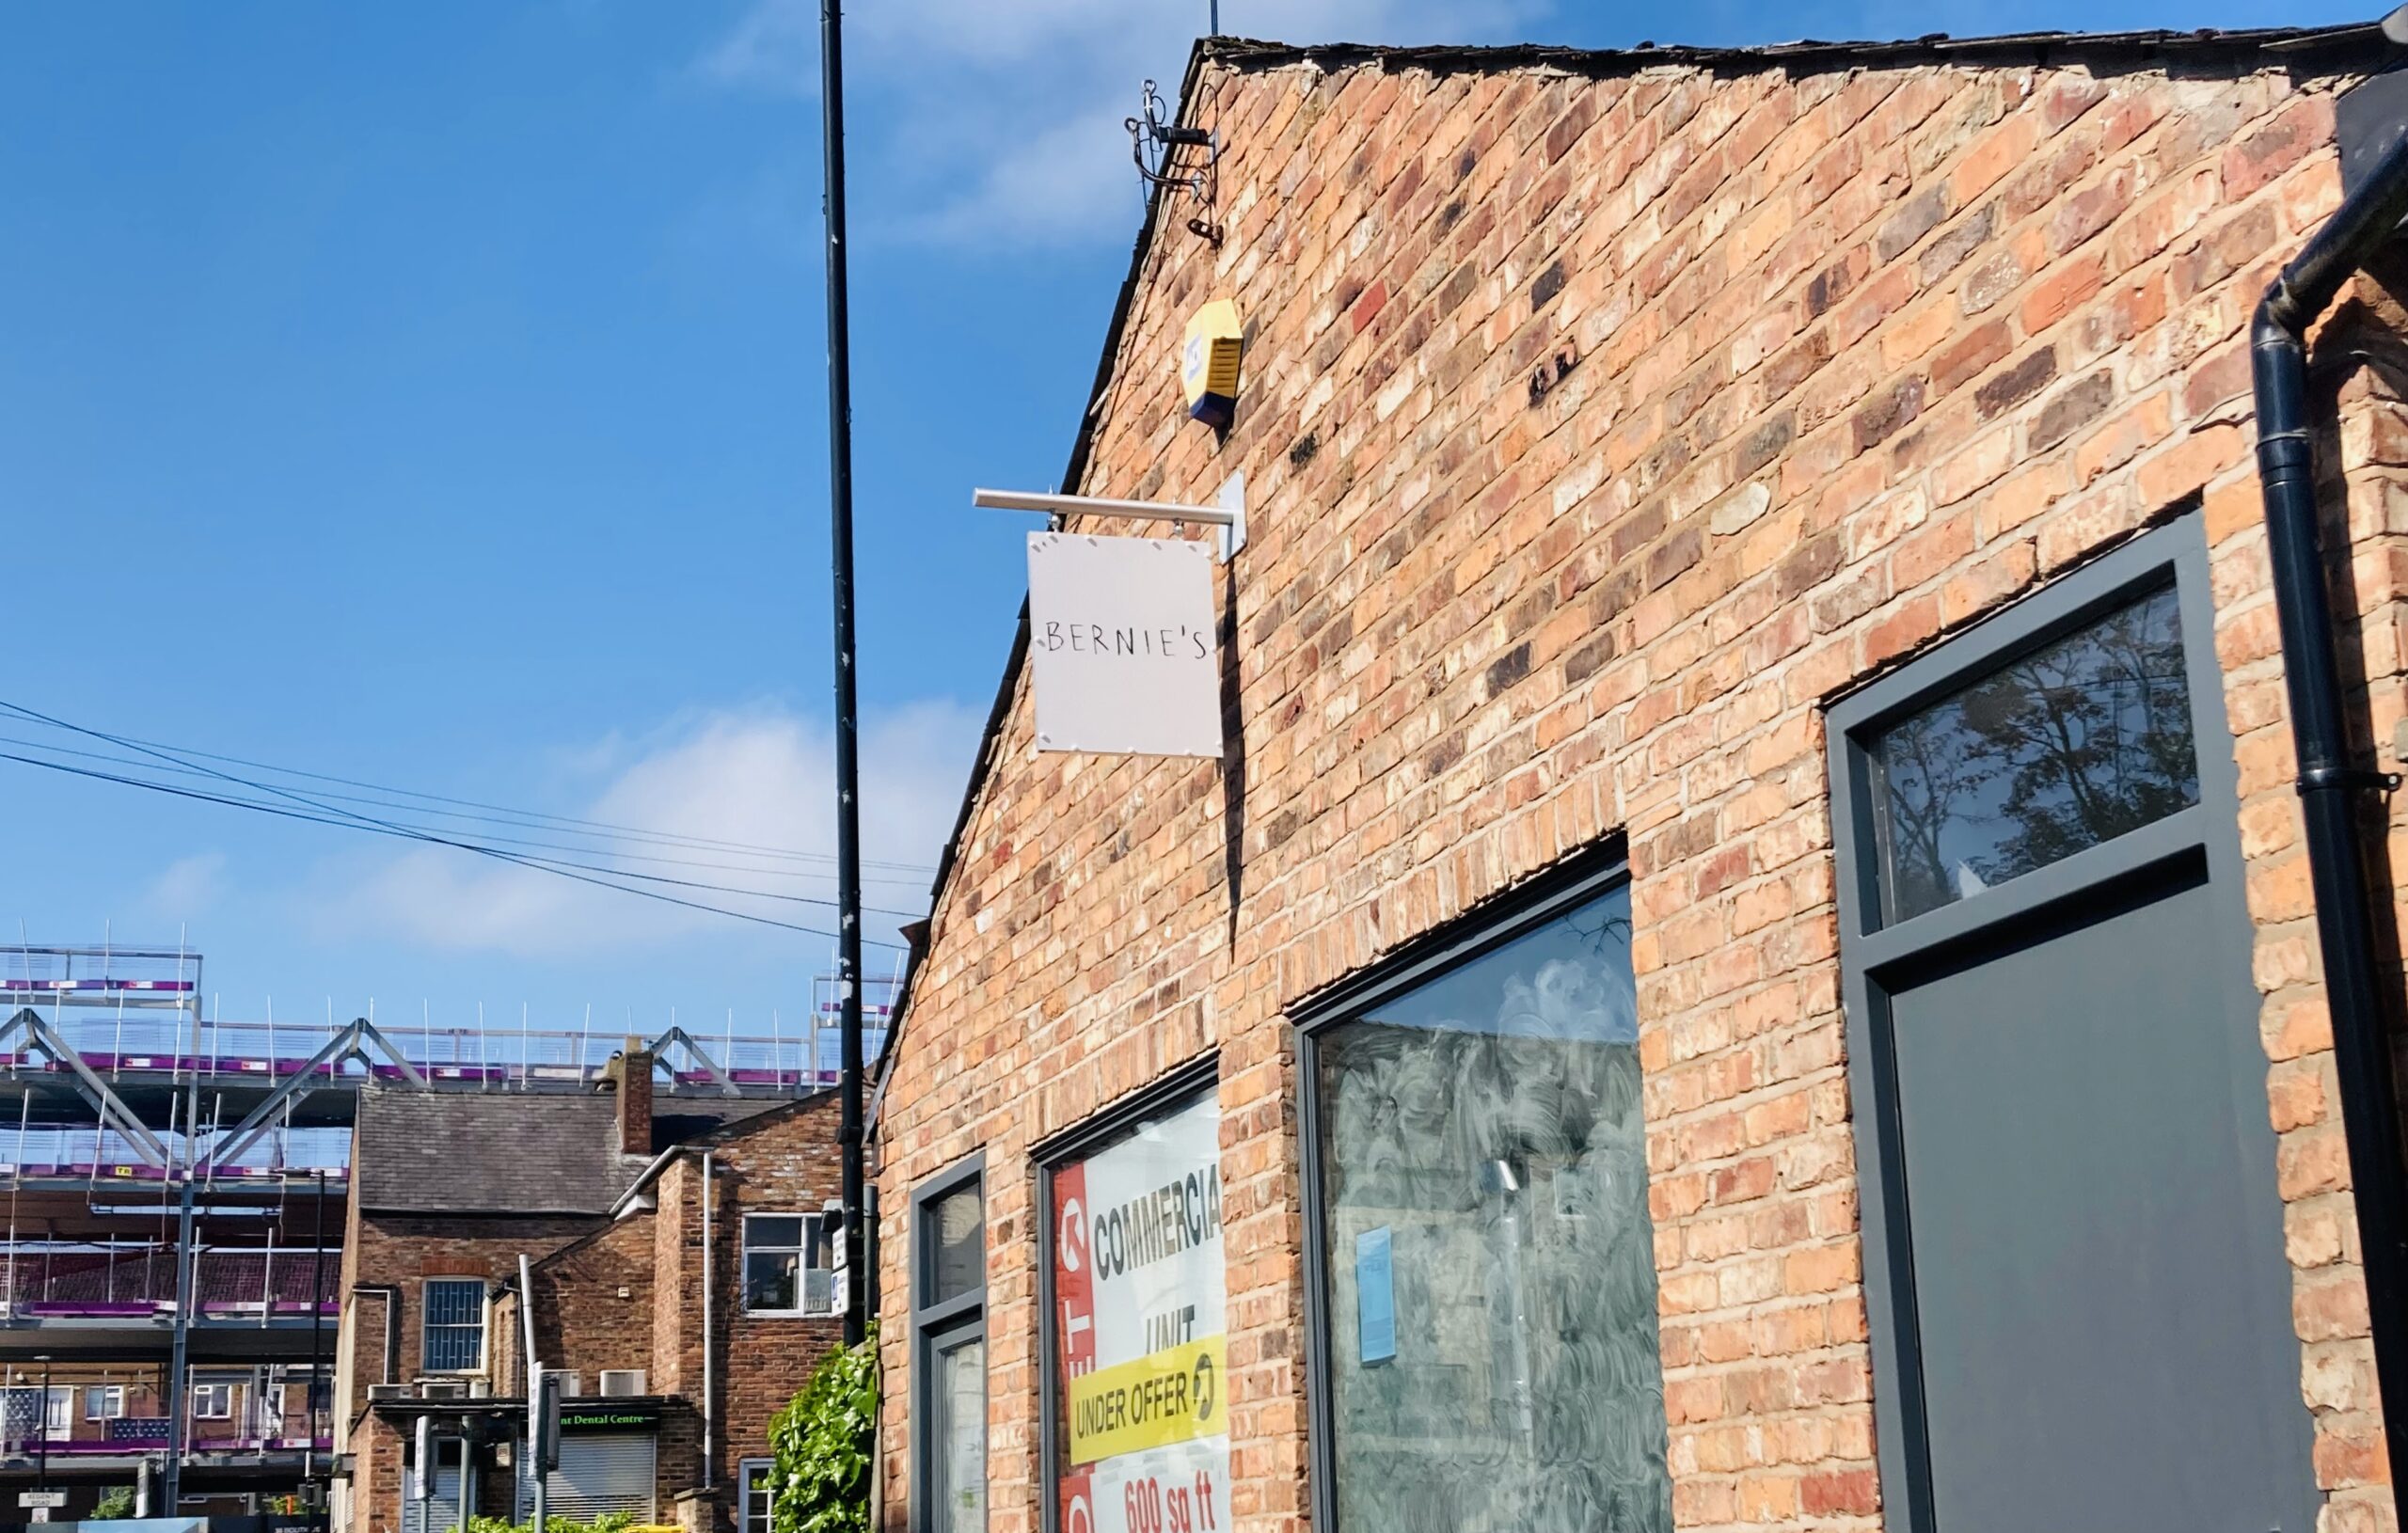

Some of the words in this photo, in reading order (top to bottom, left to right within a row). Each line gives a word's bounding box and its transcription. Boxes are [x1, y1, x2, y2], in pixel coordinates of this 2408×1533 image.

[1046, 621, 1206, 659] BERNIE'S
[574, 1414, 608, 1425] Dental
[610, 1414, 644, 1424] Centre
[1076, 1387, 1127, 1439] UNDER
[1131, 1371, 1188, 1425] OFFER
[1124, 1477, 1162, 1533] 600
[1195, 1469, 1215, 1531] ft
